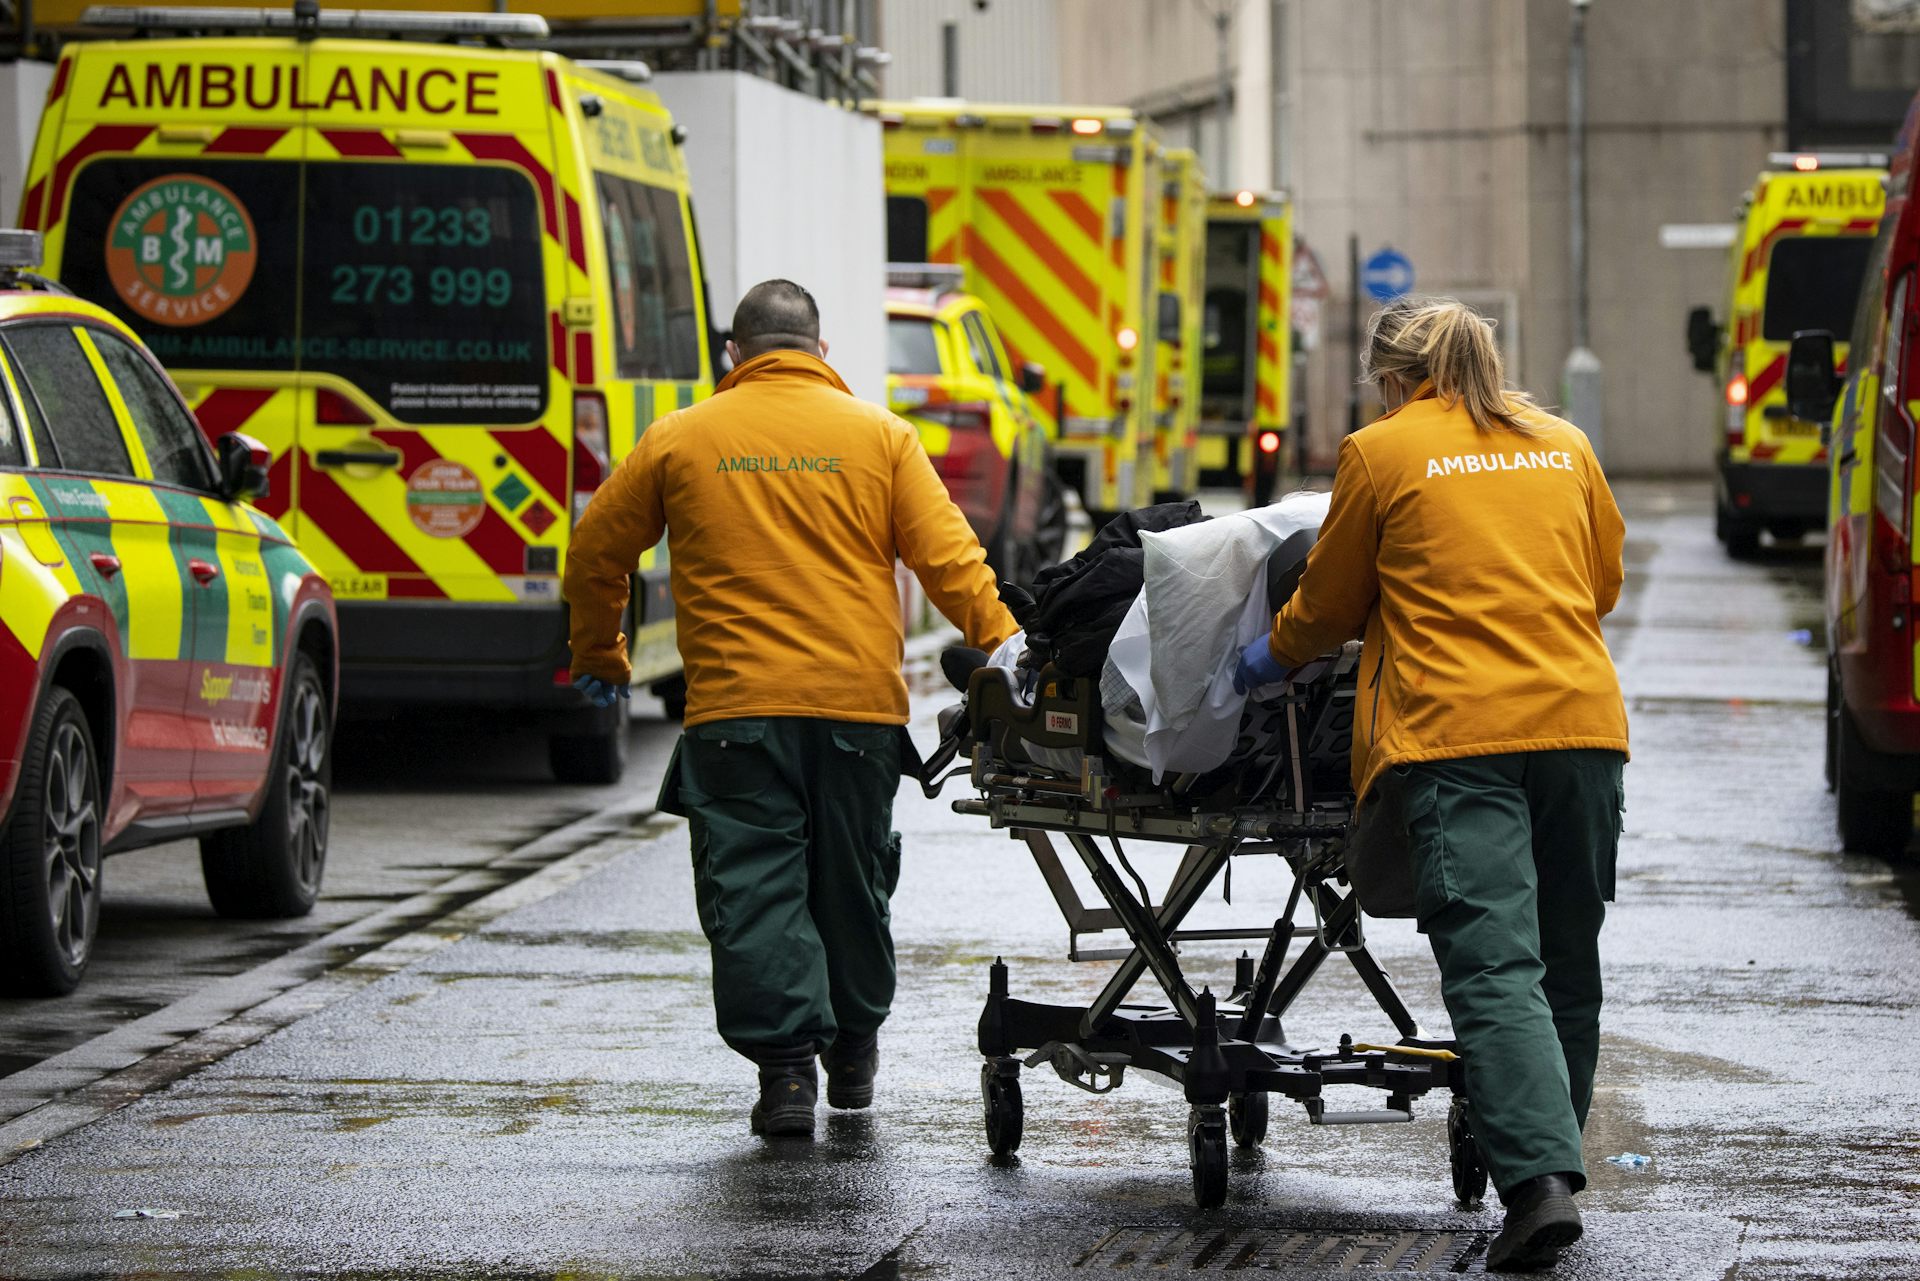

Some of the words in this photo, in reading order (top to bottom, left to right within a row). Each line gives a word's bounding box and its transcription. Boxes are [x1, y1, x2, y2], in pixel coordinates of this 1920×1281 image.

[98, 63, 500, 116] AMBULANCE
[983, 165, 1082, 183] AMBULANCE
[1786, 182, 1882, 208] AMBU
[122, 186, 244, 240] AMBULANCE
[354, 205, 492, 247] 01233
[127, 280, 231, 318] SERVICE
[332, 264, 414, 304] 273
[429, 266, 512, 307] 999
[716, 456, 842, 474] AMBULANCE
[1426, 451, 1574, 478] AMBULANCE
[332, 577, 382, 594] CLEAR
[1056, 716, 1072, 729] FERNO
